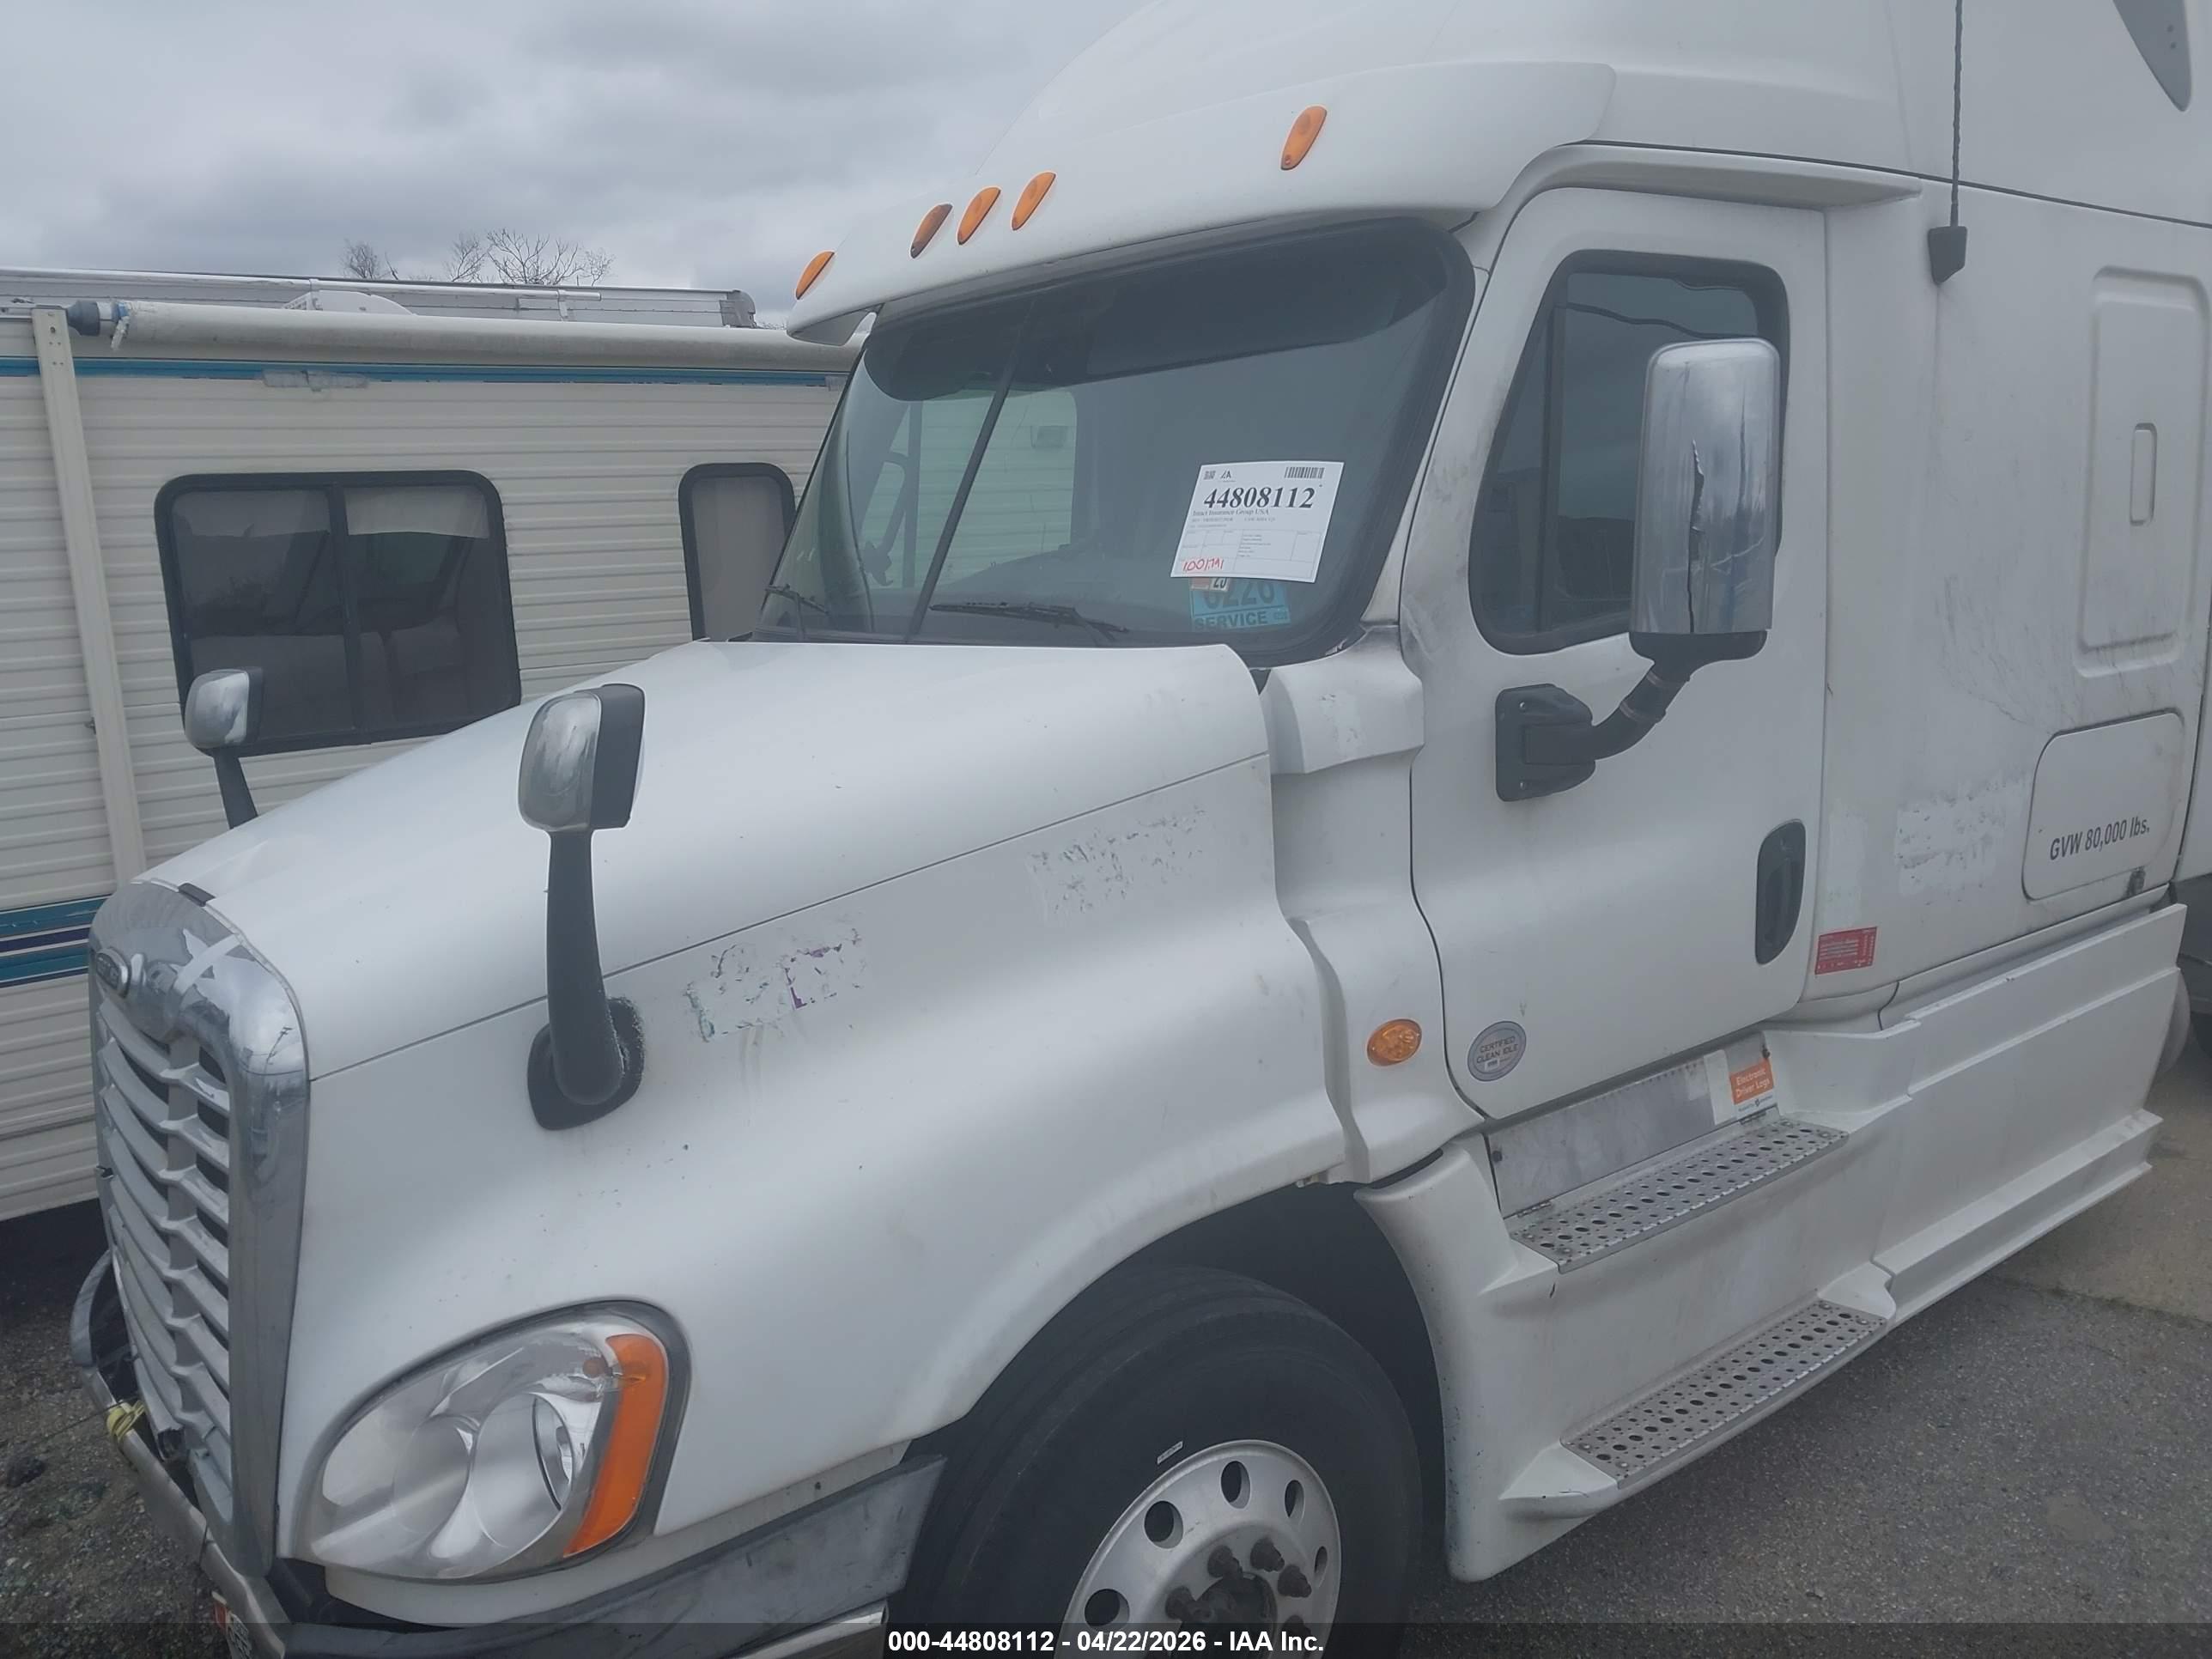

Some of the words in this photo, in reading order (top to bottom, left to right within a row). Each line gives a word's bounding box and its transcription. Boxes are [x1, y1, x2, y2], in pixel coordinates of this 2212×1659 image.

[1203, 486, 1315, 508] 44808112
[1194, 611, 1268, 630] SERVICE
[2049, 830, 2083, 861] GVW
[2084, 818, 2128, 853] 80,000
[2130, 816, 2151, 839] lbs.
[1476, 1050, 1501, 1064] CLEAN
[1503, 1043, 1519, 1055] IDLE
[1480, 1036, 1516, 1054] CERTIFIED
[1736, 1067, 1766, 1085] Electronic
[1735, 1082, 1755, 1099] Driver
[1755, 1077, 1771, 1090] Logs
